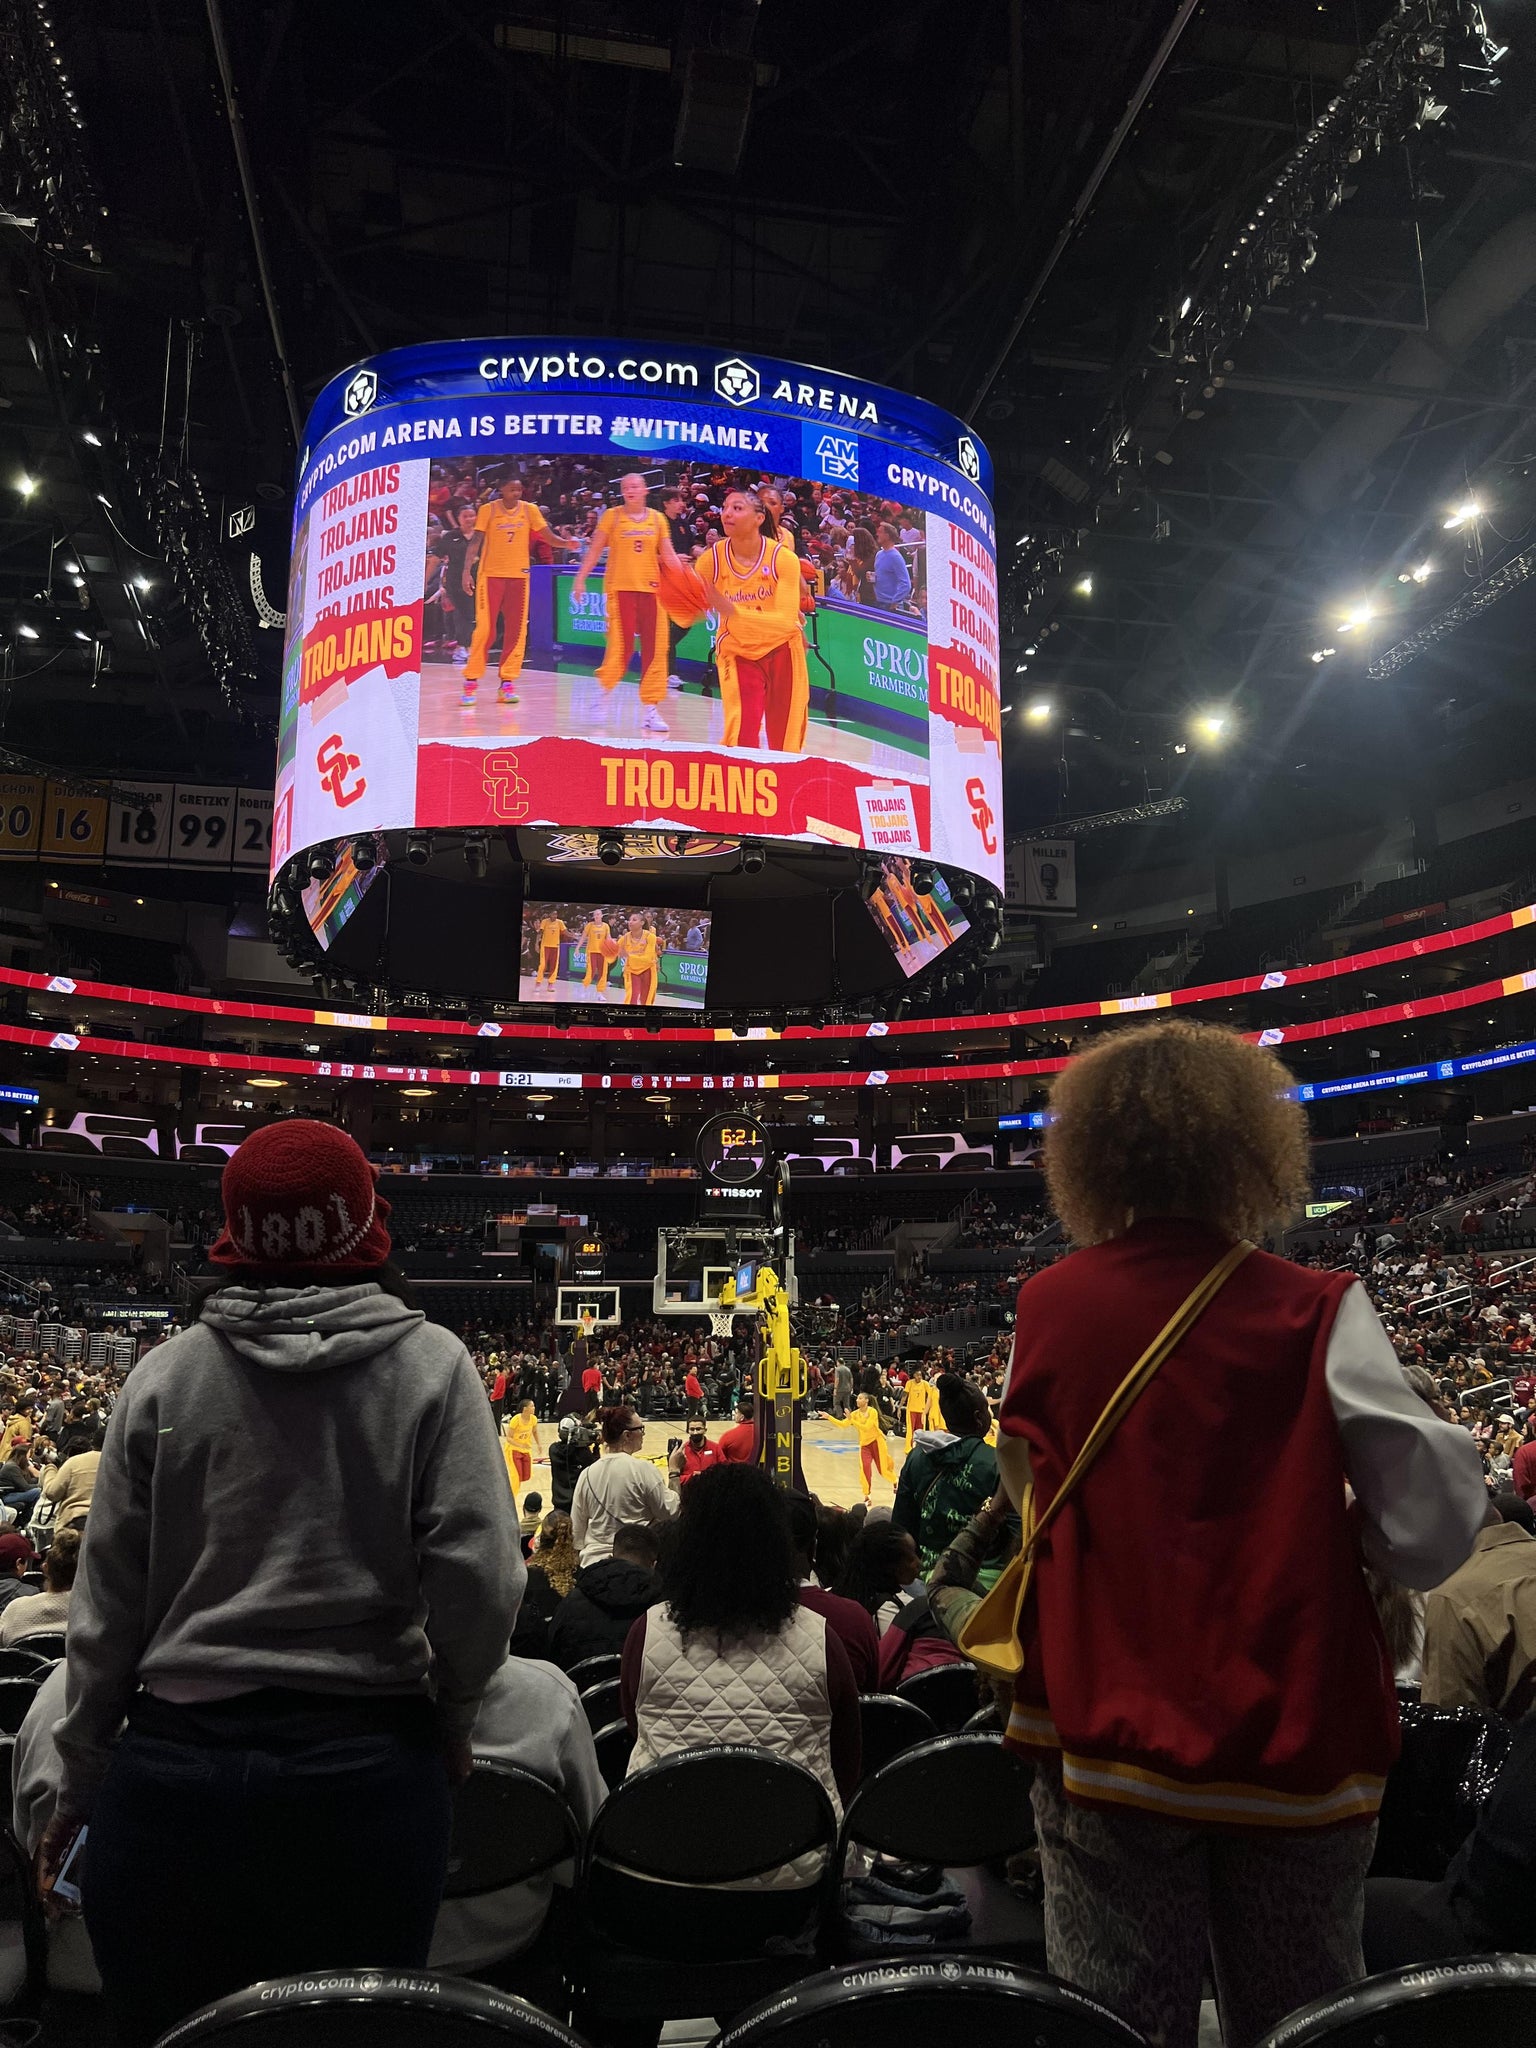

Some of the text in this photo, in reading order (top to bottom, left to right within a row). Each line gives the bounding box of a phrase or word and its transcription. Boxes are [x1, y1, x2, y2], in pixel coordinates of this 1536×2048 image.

[479, 352, 879, 424] crypto.com ARENA
[382, 417, 462, 448] ARENA
[470, 416, 495, 436] IS
[504, 414, 603, 436] BETTER
[611, 416, 769, 453] #WITHAMEX
[816, 435, 858, 462] AM
[822, 456, 859, 482] EX
[322, 464, 400, 522] TROJANS
[887, 463, 987, 531] CRYPTO.COM
[320, 504, 398, 561] TROJANS
[318, 544, 396, 600] TROJANS
[304, 614, 413, 690] TROJANS
[869, 671, 917, 699] FARMERS
[179, 793, 231, 807] GRETZKY
[601, 757, 778, 818] TROJANS
[866, 798, 906, 812] TROJANS
[55, 808, 92, 841] 16
[121, 810, 157, 844] 18
[180, 814, 227, 848] 99
[868, 814, 909, 828] TROJANS
[871, 830, 912, 844] TROJANS
[1032, 847, 1067, 858] MILLER
[505, 1073, 533, 1085] 6:21
[721, 1128, 756, 1146] 6:21
[721, 1188, 762, 1198] TISSOT
[582, 1243, 600, 1253] 6:21
[843, 1964, 1016, 1989] crypto.com ARENA
[1401, 1960, 1494, 1987] crypto.com
[261, 1975, 440, 2000] crypto.com ARENA
